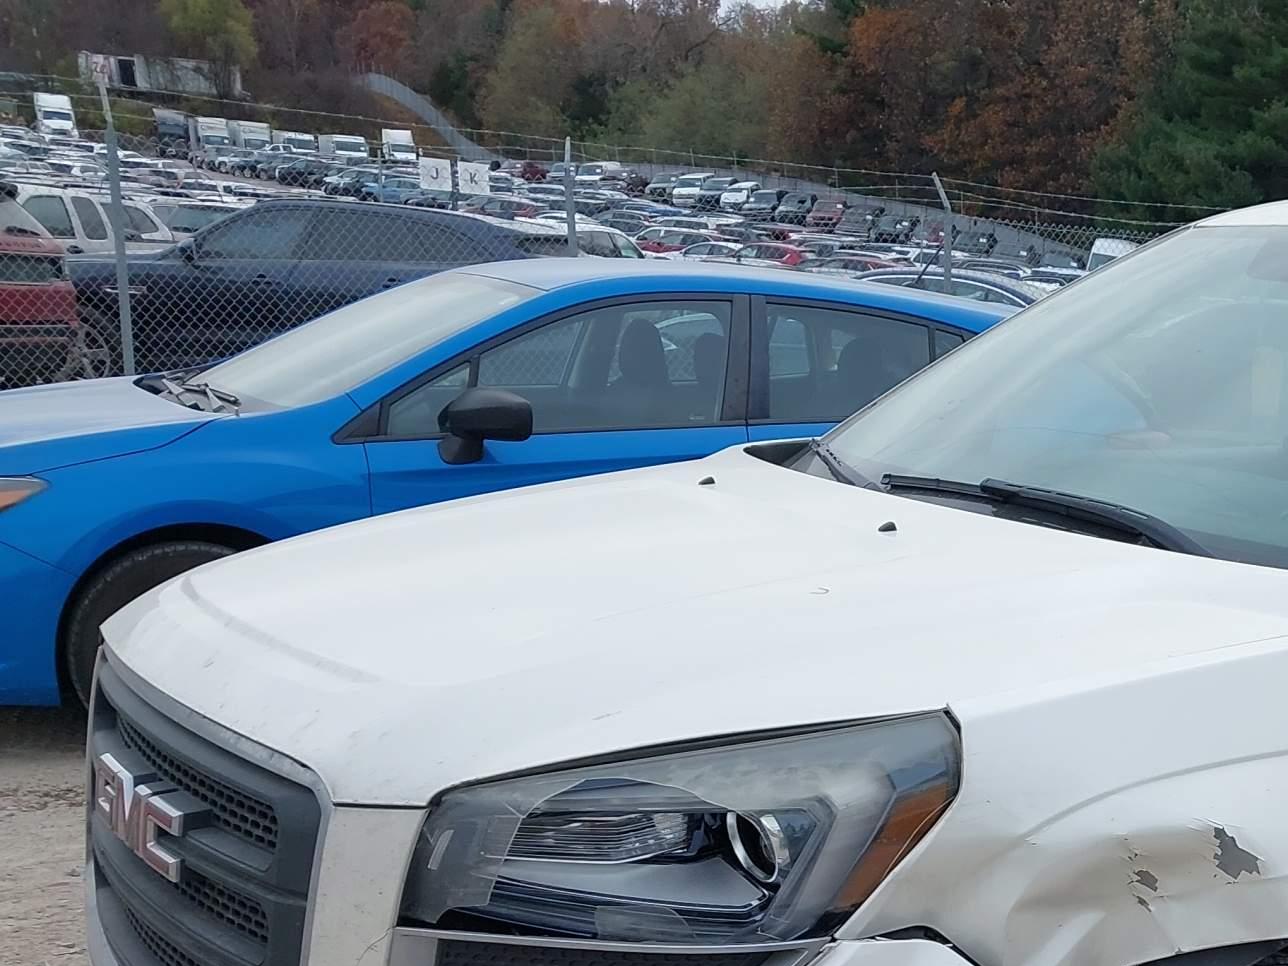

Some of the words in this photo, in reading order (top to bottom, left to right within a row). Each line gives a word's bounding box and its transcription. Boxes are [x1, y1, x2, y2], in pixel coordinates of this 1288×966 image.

[430, 167, 439, 180] J
[469, 172, 479, 185] K
[94, 752, 184, 883] GMC
